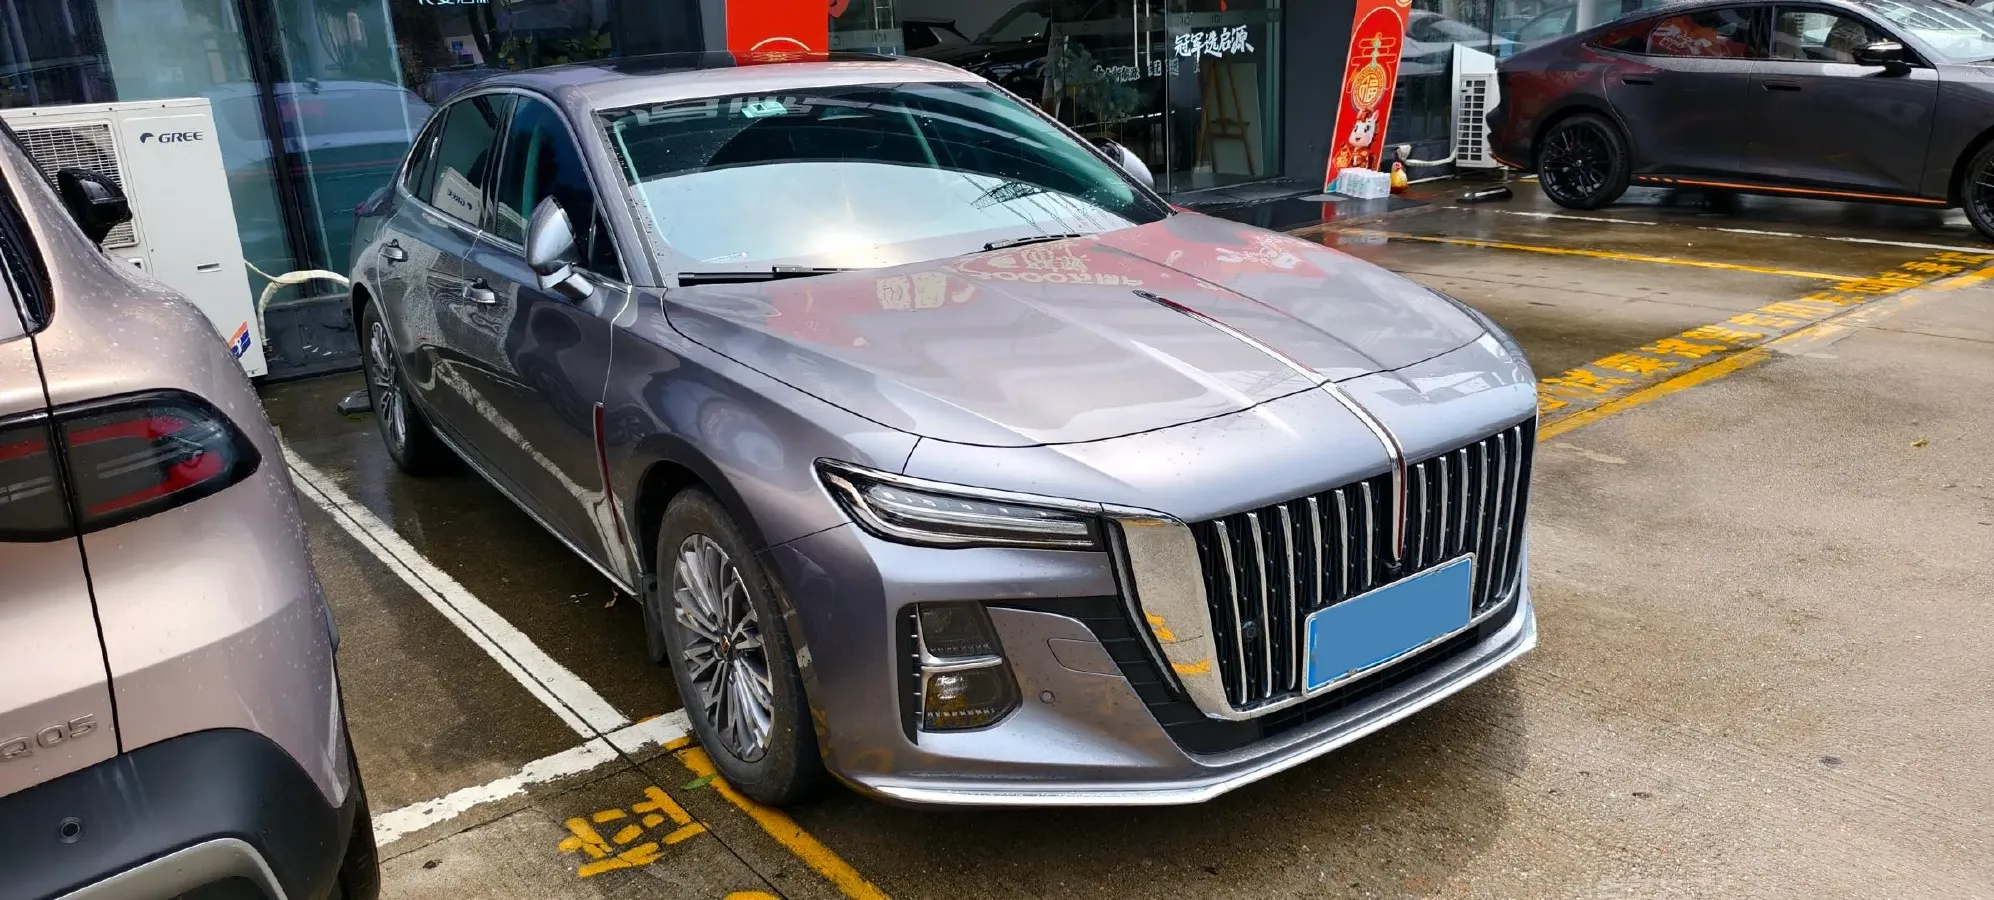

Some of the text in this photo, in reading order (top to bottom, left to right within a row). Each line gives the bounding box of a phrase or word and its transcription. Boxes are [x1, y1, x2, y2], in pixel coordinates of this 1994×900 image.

[1175, 25, 1254, 63] 冠军选启源
[1359, 73, 1379, 103] 福
[158, 131, 203, 143] GREE
[0, 713, 97, 761] Q05
